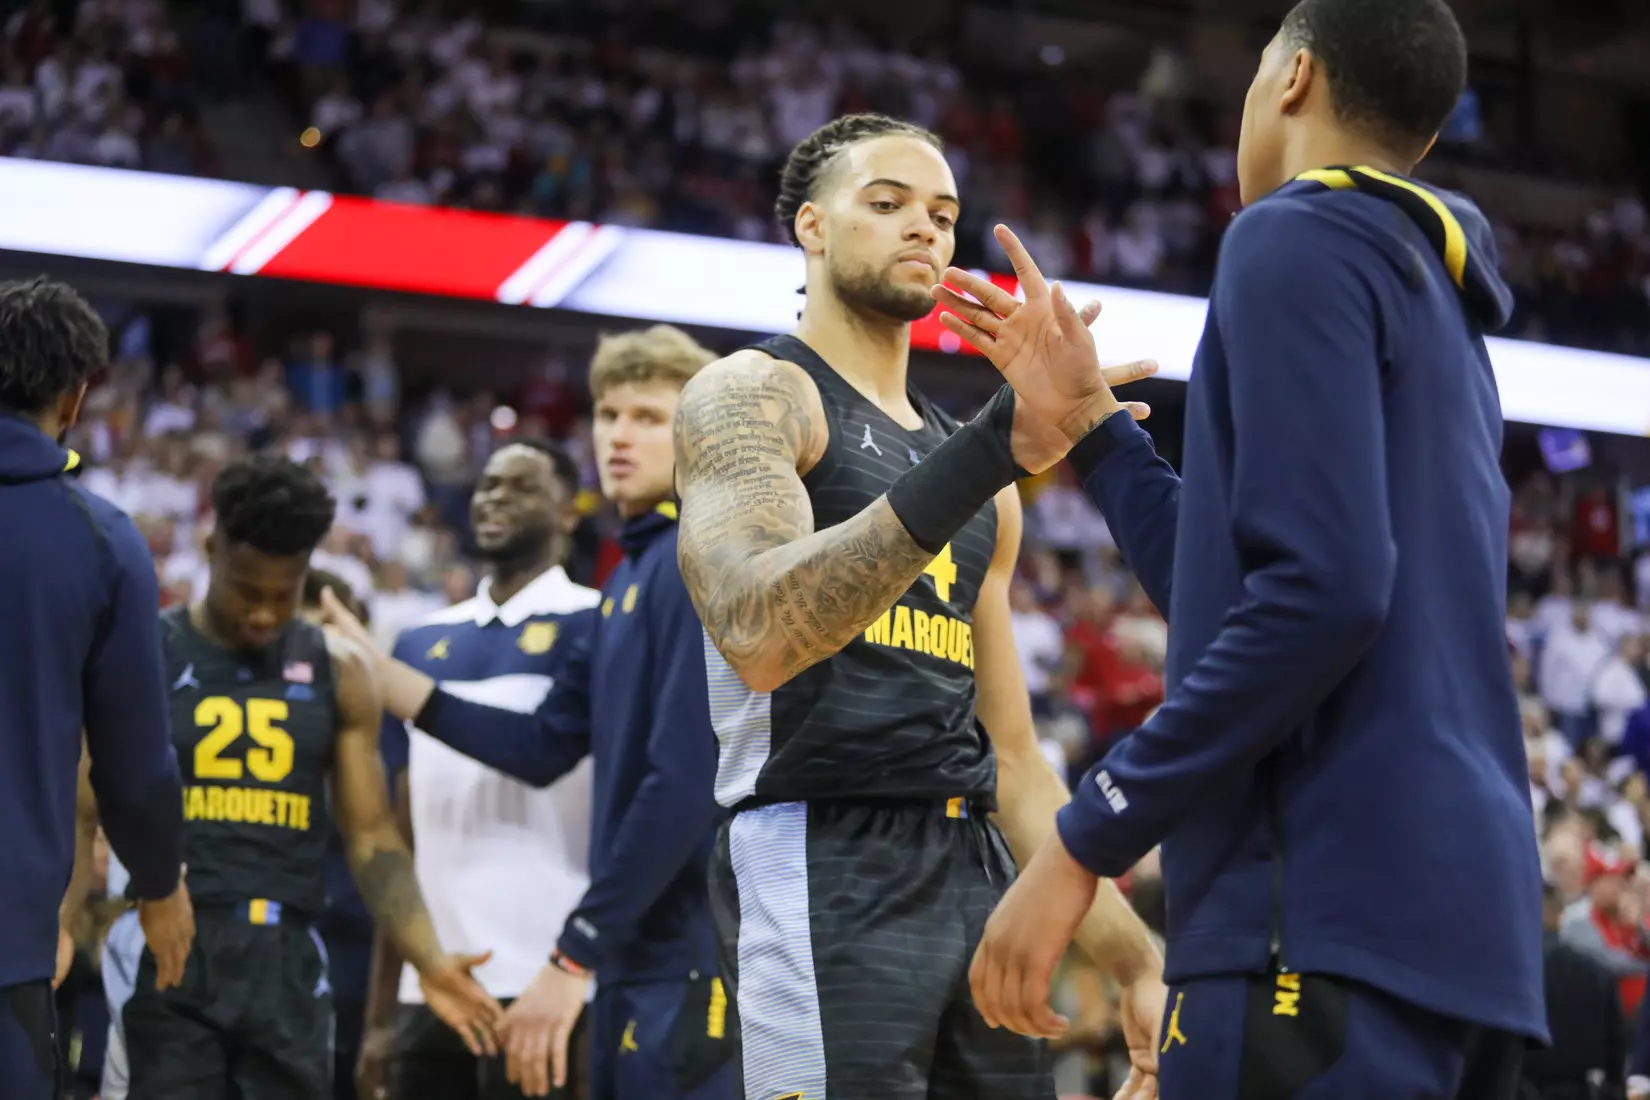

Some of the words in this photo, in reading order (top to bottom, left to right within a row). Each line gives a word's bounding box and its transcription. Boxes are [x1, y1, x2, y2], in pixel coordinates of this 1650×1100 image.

[923, 541, 957, 603] 4
[864, 605, 974, 670] MARQUE
[194, 696, 295, 782] 25
[182, 785, 311, 831] ARQUETTE
